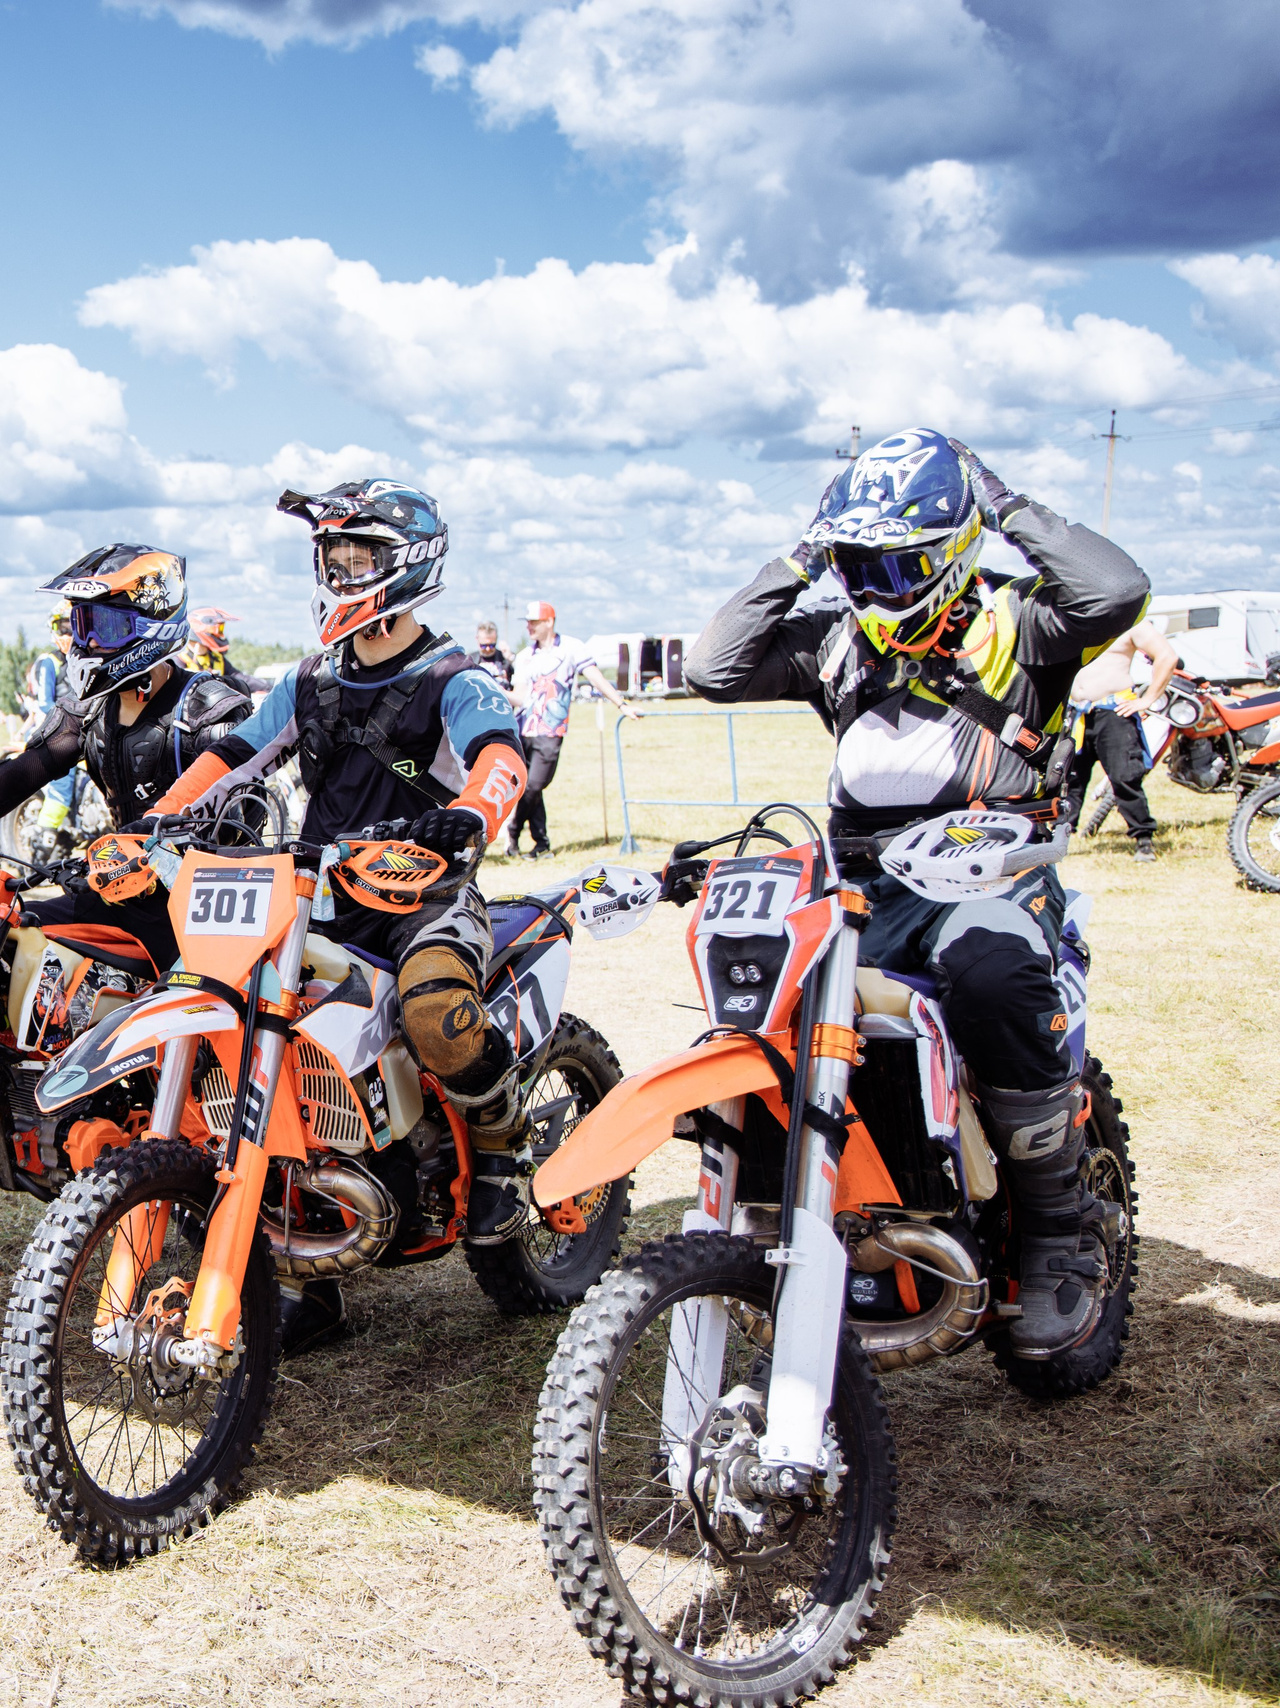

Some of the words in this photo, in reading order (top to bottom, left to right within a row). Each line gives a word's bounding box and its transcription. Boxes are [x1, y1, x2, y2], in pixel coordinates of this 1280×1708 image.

[326, 612, 342, 636] Airoh
[108, 864, 131, 881] CYCRA
[355, 877, 380, 896] CYCRA
[191, 888, 258, 924] 301
[593, 900, 619, 917] CYCRA
[703, 880, 777, 920] 321
[109, 1054, 149, 1075] MOTUL
